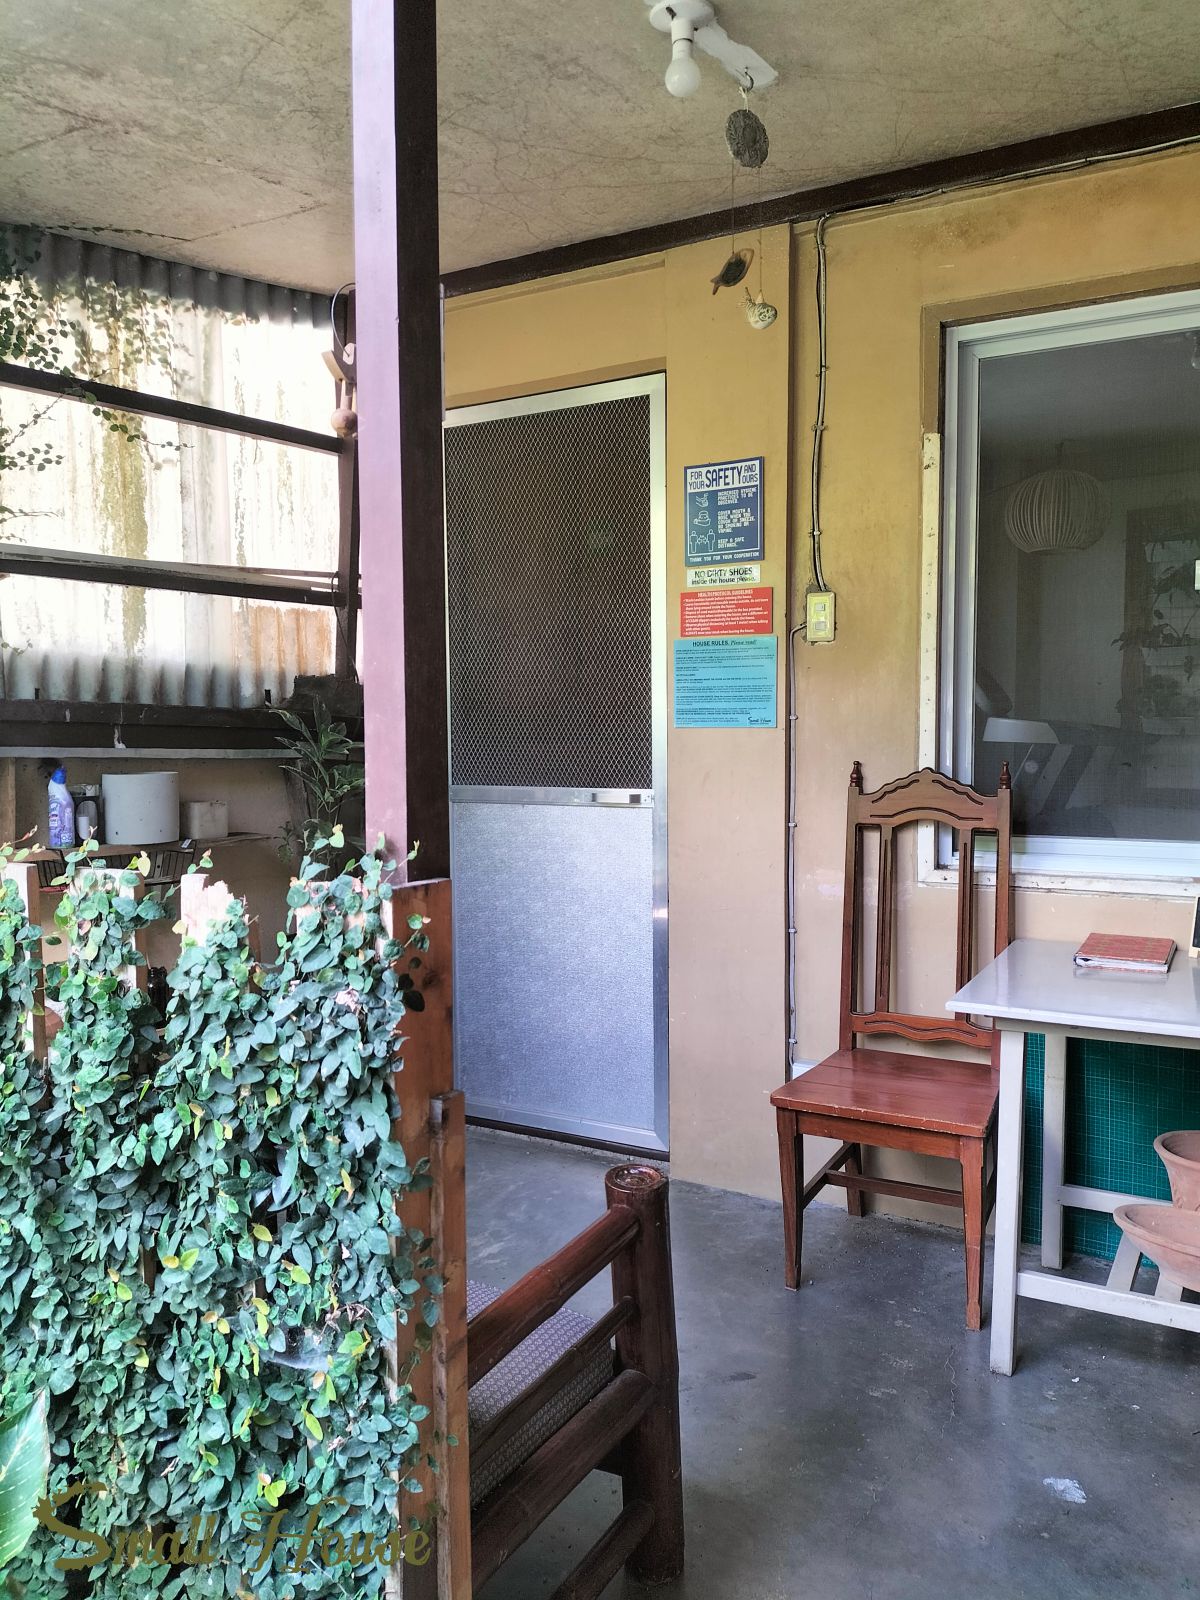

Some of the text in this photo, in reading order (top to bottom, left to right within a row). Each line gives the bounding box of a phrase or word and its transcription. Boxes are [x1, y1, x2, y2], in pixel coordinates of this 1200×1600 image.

[744, 464, 756, 474] AND
[690, 470, 702, 480] FOR
[705, 465, 743, 488] SAFETY
[742, 473, 758, 484] OURS
[689, 480, 704, 490] YOUR
[707, 569, 727, 577] DIRTY
[729, 567, 753, 576] SHOES
